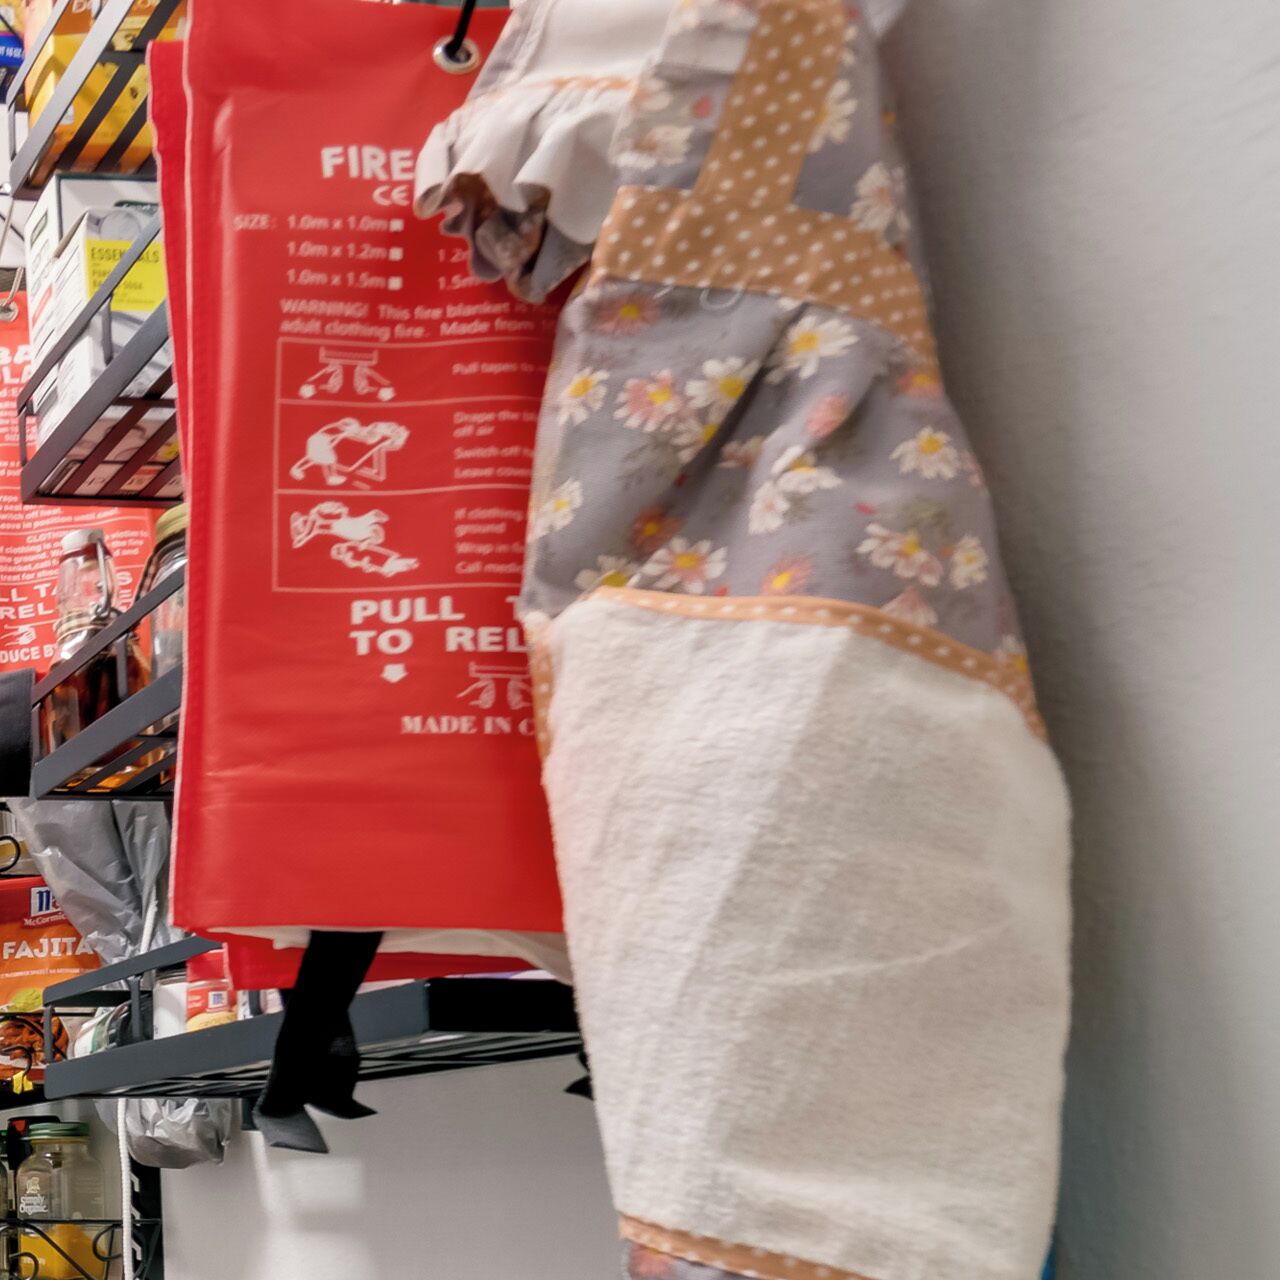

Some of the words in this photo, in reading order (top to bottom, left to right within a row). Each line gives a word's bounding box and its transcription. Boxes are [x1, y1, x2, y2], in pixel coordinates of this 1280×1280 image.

[321, 144, 414, 182] FIRE
[345, 243, 388, 260] 1.2m
[345, 270, 387, 290] 1.5m
[280, 298, 370, 319] WARNING!
[378, 304, 410, 320] This
[414, 304, 443, 320] fire
[446, 301, 510, 317] blanket
[280, 319, 320, 336] adult
[324, 321, 391, 341] clothing
[440, 321, 489, 338] Made
[495, 318, 534, 333] from
[350, 595, 466, 625] PULL
[348, 628, 414, 656] TO
[400, 715, 477, 735] MADE
[483, 716, 513, 735] IN
